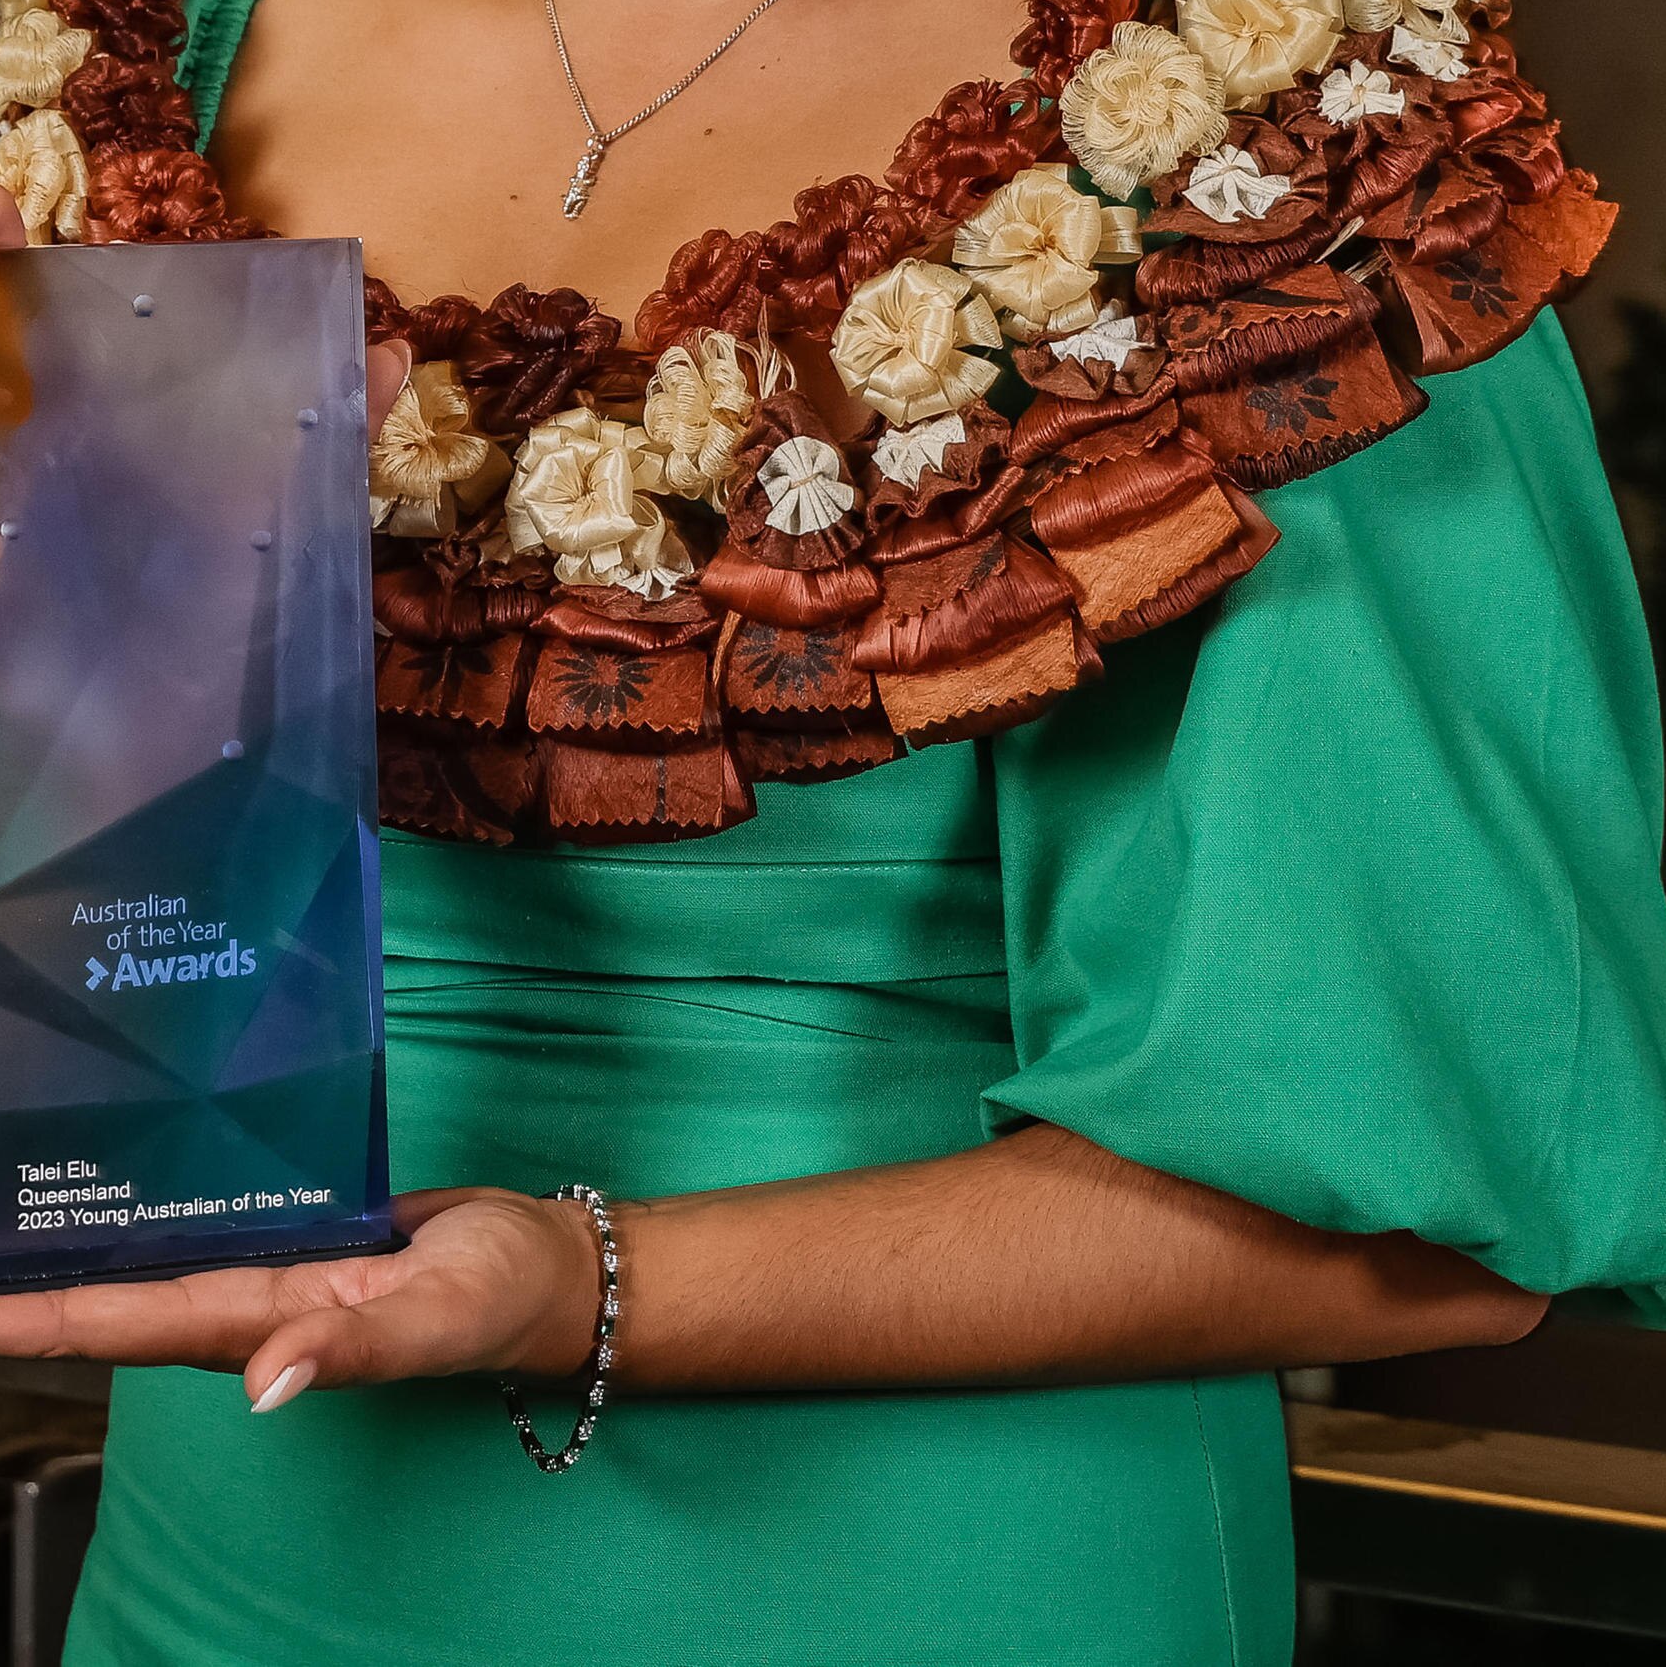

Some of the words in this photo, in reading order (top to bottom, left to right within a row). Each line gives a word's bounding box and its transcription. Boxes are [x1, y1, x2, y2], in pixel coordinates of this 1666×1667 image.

[72, 894, 186, 925] Australian
[107, 925, 131, 951] of
[138, 923, 176, 947] the
[178, 920, 227, 943] Year
[111, 938, 257, 991] Awards
[18, 1161, 60, 1182] Talei
[67, 1160, 97, 1179] Elu
[17, 1211, 65, 1230] 2023
[69, 1207, 129, 1227] Young
[133, 1198, 226, 1221] Australian
[232, 1194, 252, 1211] of
[256, 1191, 284, 1208] the
[288, 1187, 331, 1205] Year
[18, 1181, 130, 1207] Queensland
